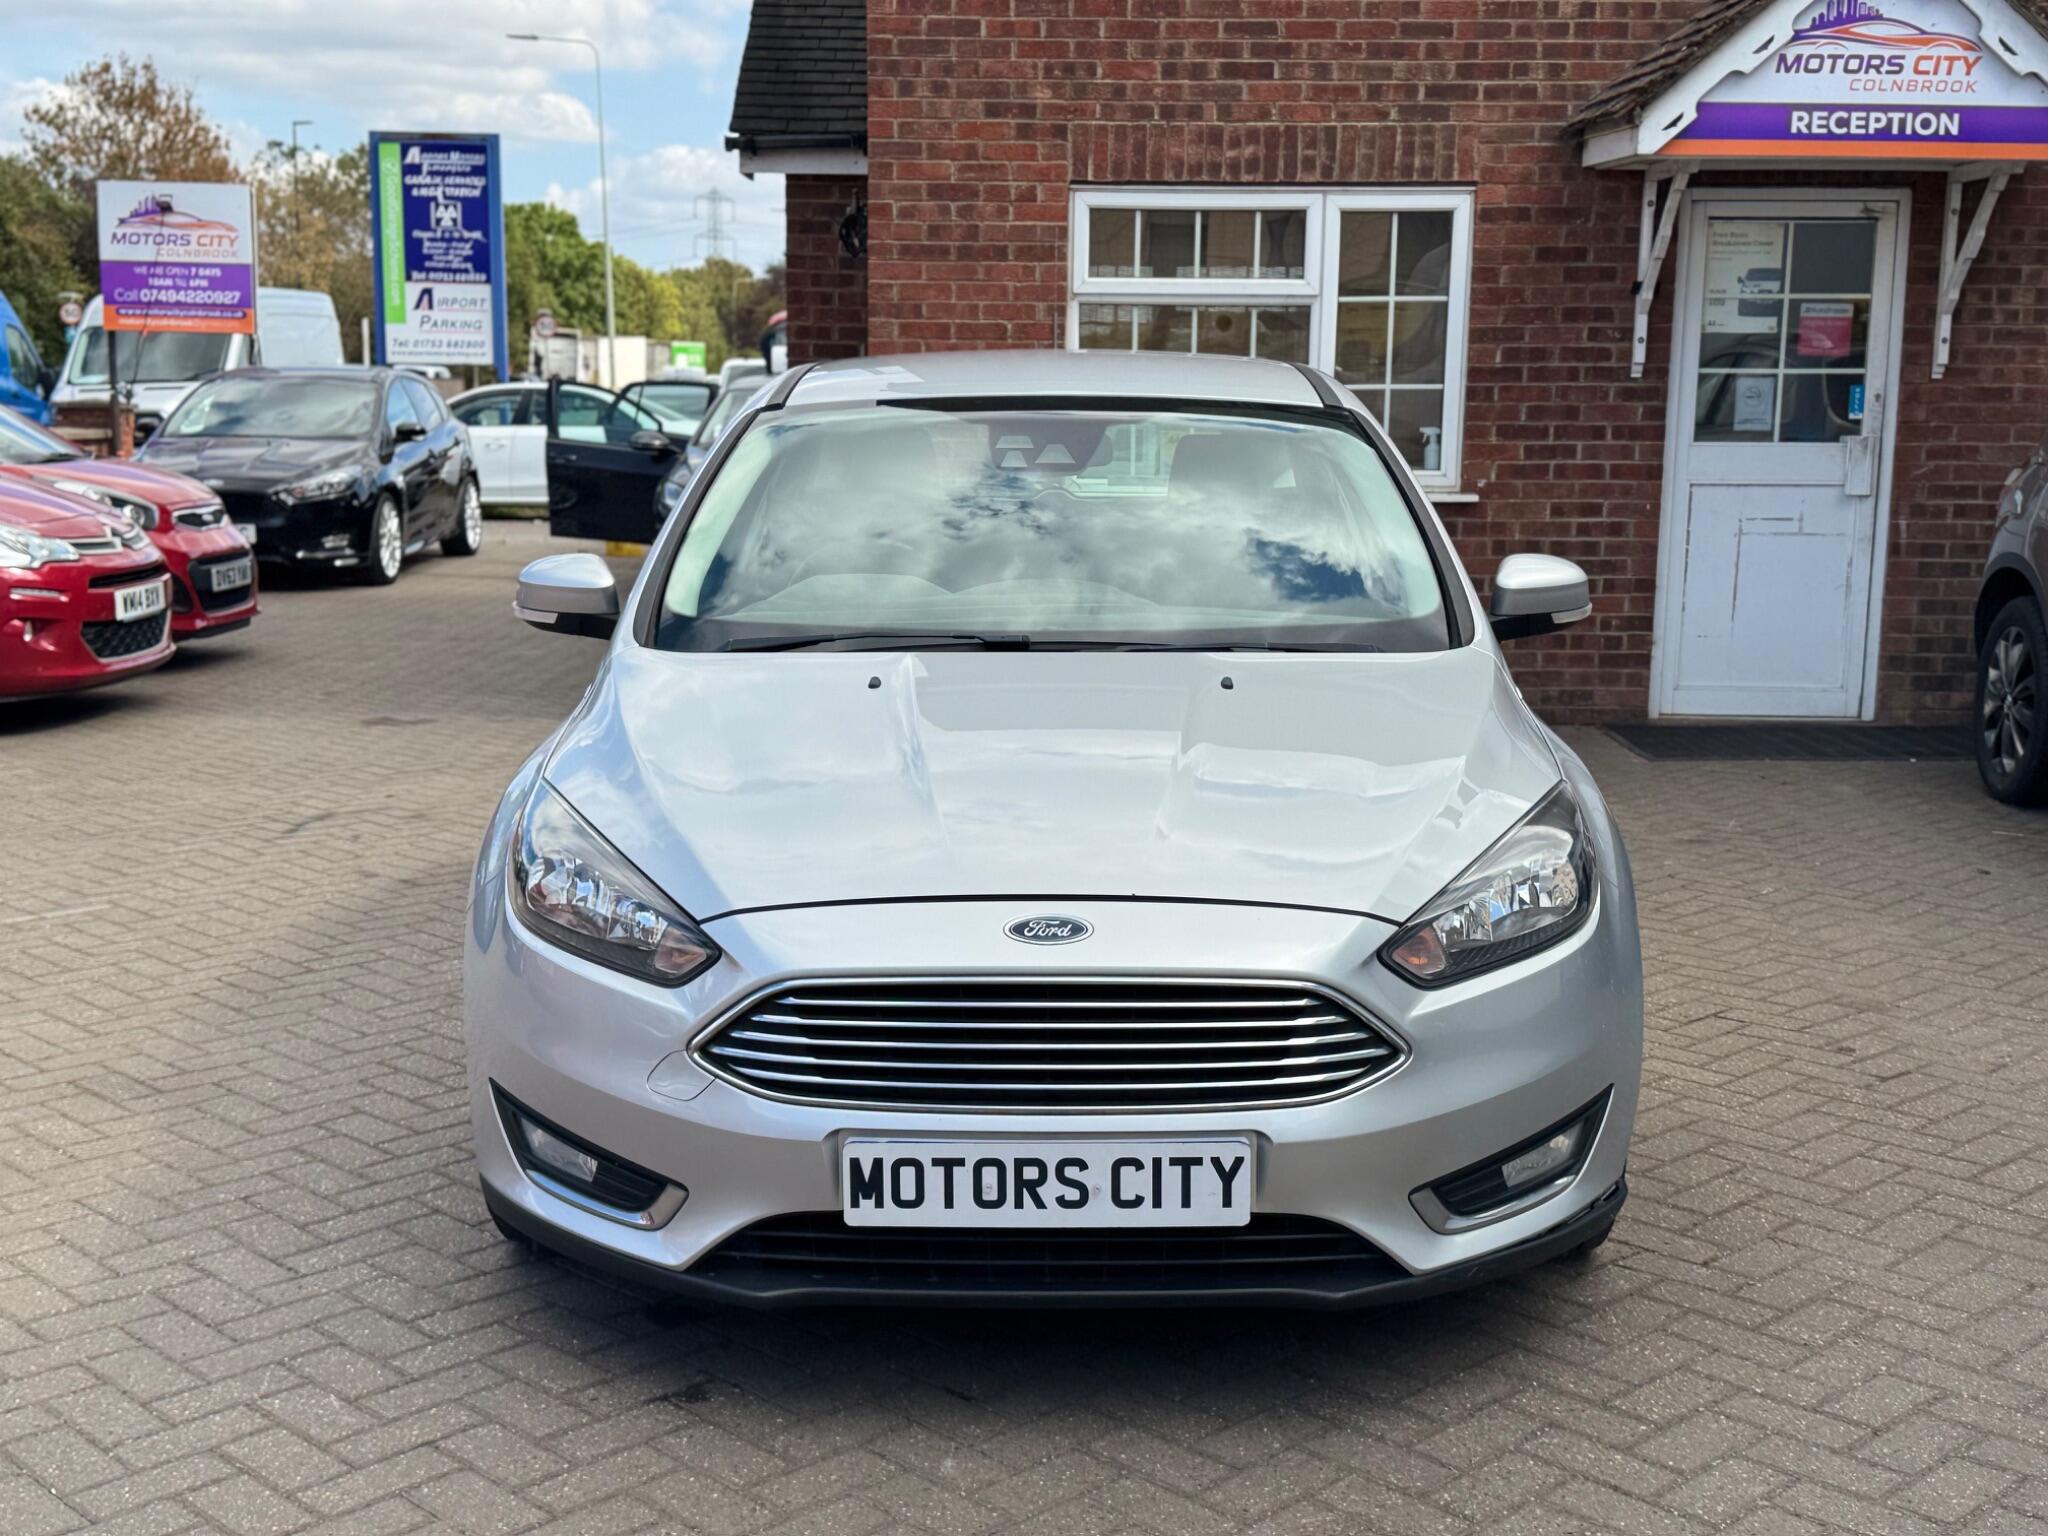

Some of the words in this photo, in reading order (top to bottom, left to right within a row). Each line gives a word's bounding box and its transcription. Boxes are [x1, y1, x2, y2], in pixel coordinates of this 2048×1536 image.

[1775, 53, 1905, 76] MOTORS
[1912, 55, 1983, 76] CITY
[1849, 79, 1977, 93] COLNBROOK
[1790, 110, 1960, 136] RECEPTION
[110, 232, 192, 247] MOTORS
[196, 234, 240, 248] CITY
[156, 249, 239, 259] COLNBROOK
[114, 288, 138, 301] Call
[413, 287, 487, 311] AIRPORT
[420, 315, 482, 330] PARKING
[1024, 919, 1072, 936] Ford
[849, 1156, 1090, 1210] MOTORS
[1110, 1156, 1245, 1210] CITY
